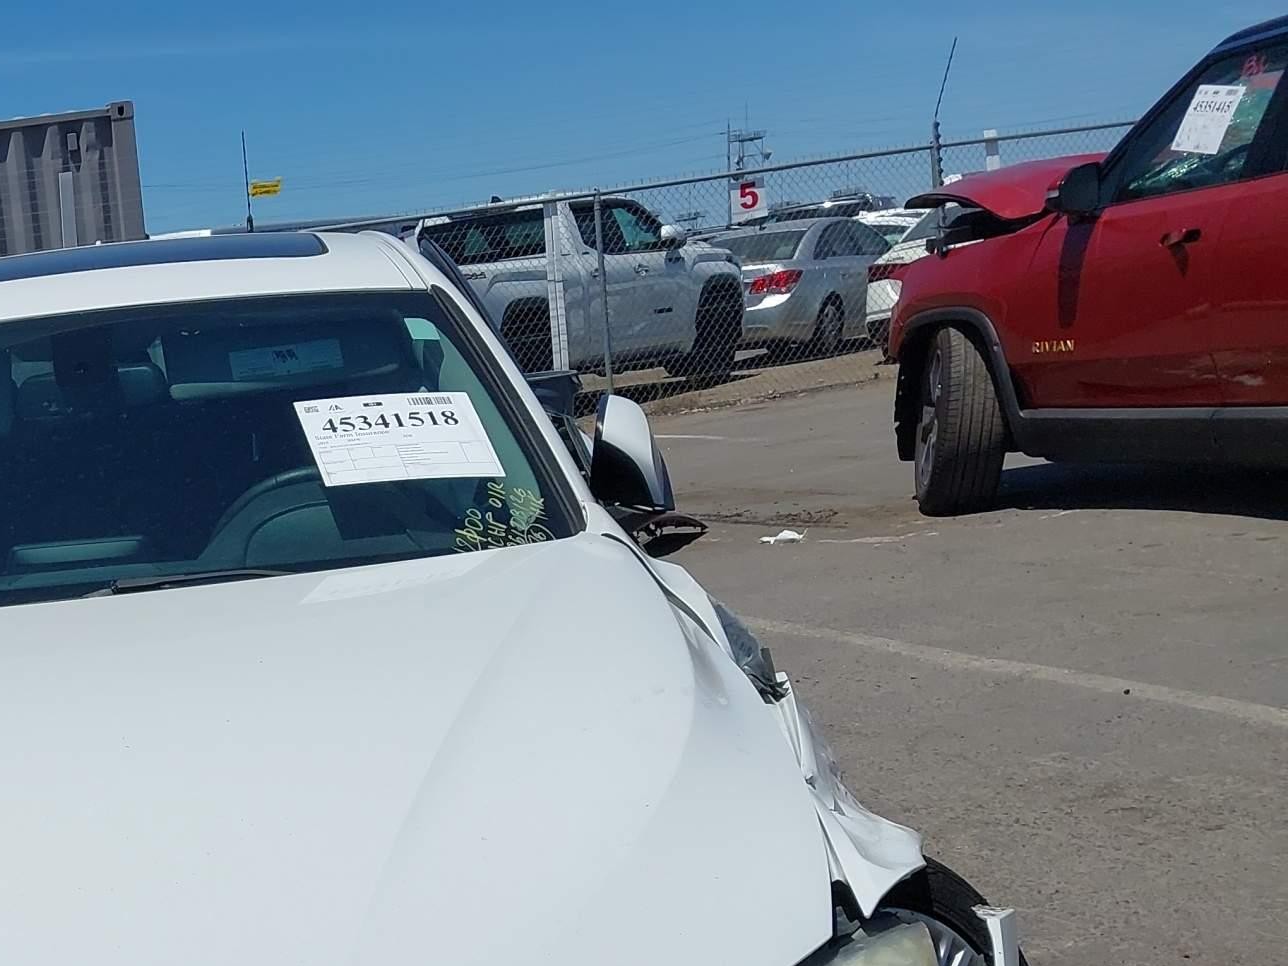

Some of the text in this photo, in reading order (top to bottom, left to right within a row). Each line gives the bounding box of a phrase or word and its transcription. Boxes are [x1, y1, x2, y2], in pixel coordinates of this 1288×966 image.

[740, 181, 760, 209] 5
[1032, 339, 1075, 353] RIVIAN
[322, 410, 459, 433] 45341518
